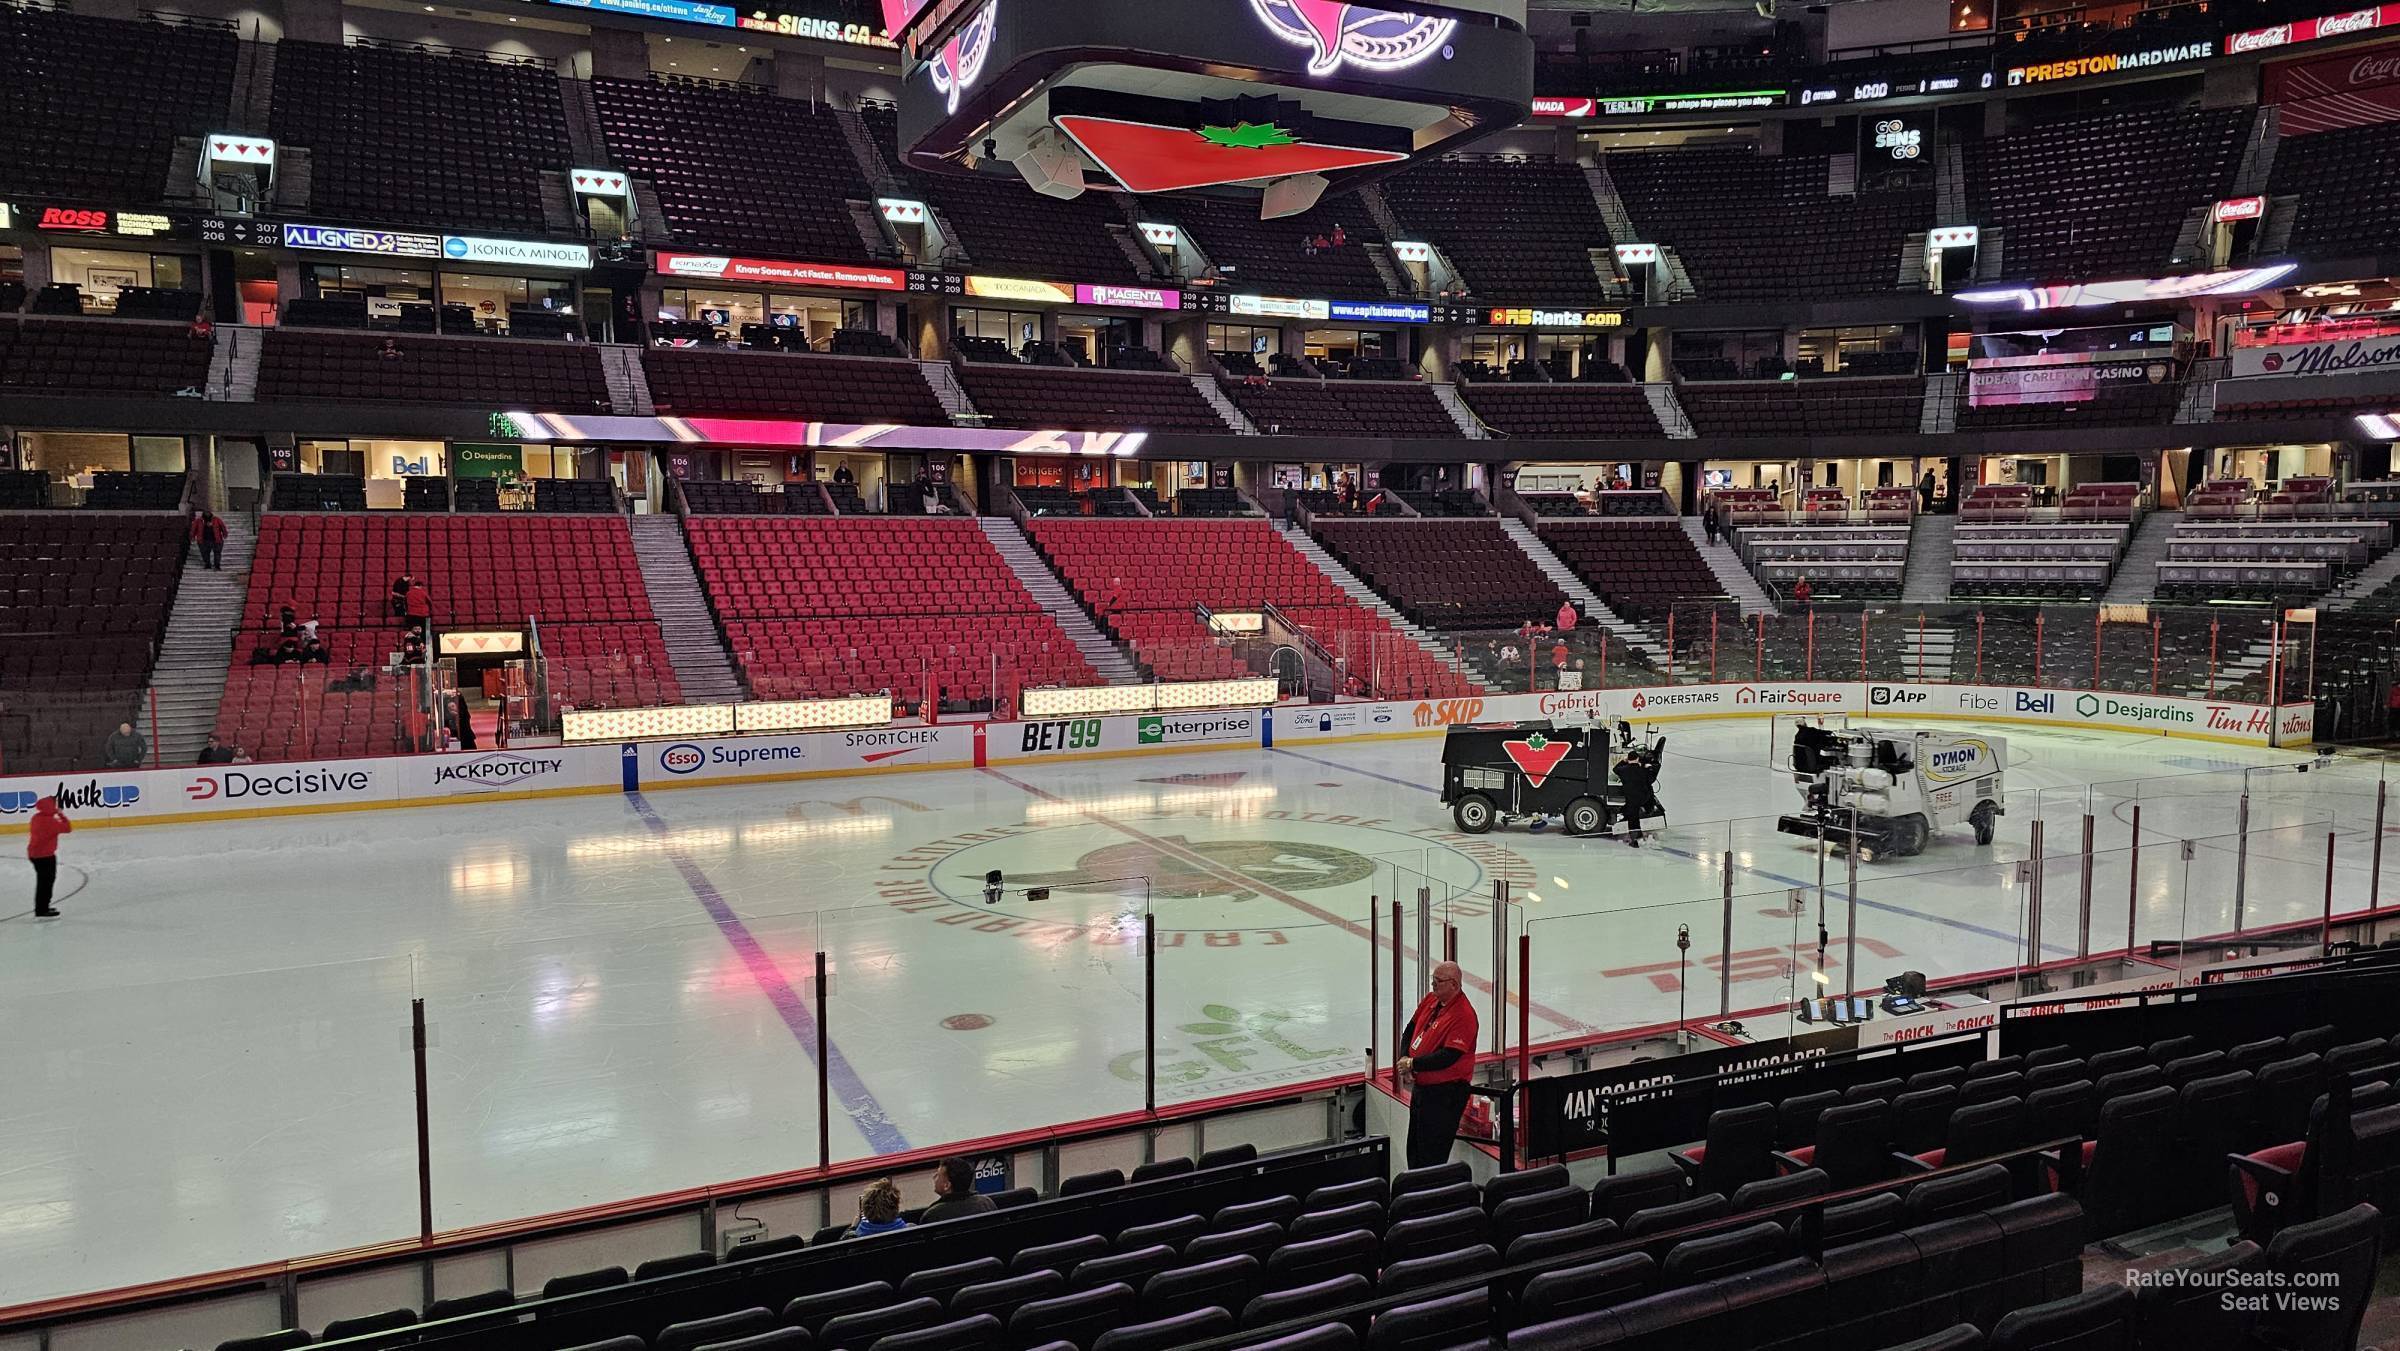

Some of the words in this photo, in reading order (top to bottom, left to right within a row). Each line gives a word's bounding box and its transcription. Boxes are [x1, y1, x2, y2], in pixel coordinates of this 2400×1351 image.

[778, 14, 871, 45] SIGNS.CA
[2321, 8, 2375, 35] Coca-Cola
[2235, 25, 2287, 51] Coca-Cola
[1532, 100, 1565, 112] ANADA
[1677, 101, 1699, 111] shape
[1700, 99, 1713, 108] the
[1737, 98, 1752, 108] you
[1752, 96, 1773, 108] shop
[1876, 119, 1903, 134] GO
[1875, 130, 1920, 147] SENS
[1892, 145, 1920, 159] GO
[43, 208, 106, 225] ROSS
[202, 220, 224, 229] 306
[256, 223, 277, 233] 307
[203, 231, 225, 241] 206
[257, 236, 278, 245] 207
[287, 229, 378, 249] ALIGNED
[473, 243, 526, 257] KONICA
[530, 248, 587, 262] MINOLTA
[736, 264, 760, 275] Know
[761, 266, 793, 277] Sooner.
[794, 268, 807, 278] Act
[808, 269, 834, 281] Faster.
[835, 271, 867, 282] Remove
[868, 273, 895, 284] Waste.
[910, 272, 926, 281] 308
[944, 275, 961, 284] 309
[910, 282, 926, 291] 208
[945, 285, 961, 294] 209
[1108, 289, 1163, 302] MAGENTA
[1183, 302, 1197, 310] 209
[1214, 304, 1227, 312] 210
[1214, 295, 1227, 303] 310
[1332, 305, 1428, 320] www.capitalsecurity.ca
[1433, 306, 1445, 314] 310
[2093, 367, 2143, 380] CASINO
[272, 450, 291, 458] 105
[474, 452, 513, 461] Desjardins
[393, 456, 428, 475] Bell
[1540, 692, 1601, 715] Gabriel
[1649, 693, 1719, 705] POKERSTARS
[1760, 689, 1841, 706] FairSquare
[1959, 693, 1998, 709] Fibe
[2016, 692, 2054, 713] Bell
[1295, 714, 1315, 724] Ford
[1434, 699, 1484, 724] SKIP
[2106, 700, 2194, 722] Desjardins
[2207, 706, 2243, 732] Tim
[1022, 719, 1102, 752] BET99
[1145, 717, 1250, 737] enterprise
[668, 752, 699, 765] Esso
[712, 746, 801, 767] Supreme
[1933, 749, 1975, 767] DYMON
[434, 760, 562, 784] JACKPOTCITY
[224, 768, 369, 798] Decisive
[1946, 1022, 1957, 1031] The
[1957, 1014, 1995, 1031] BRICK
[1883, 1032, 1894, 1041] The
[1895, 1025, 1934, 1042] BRICK
